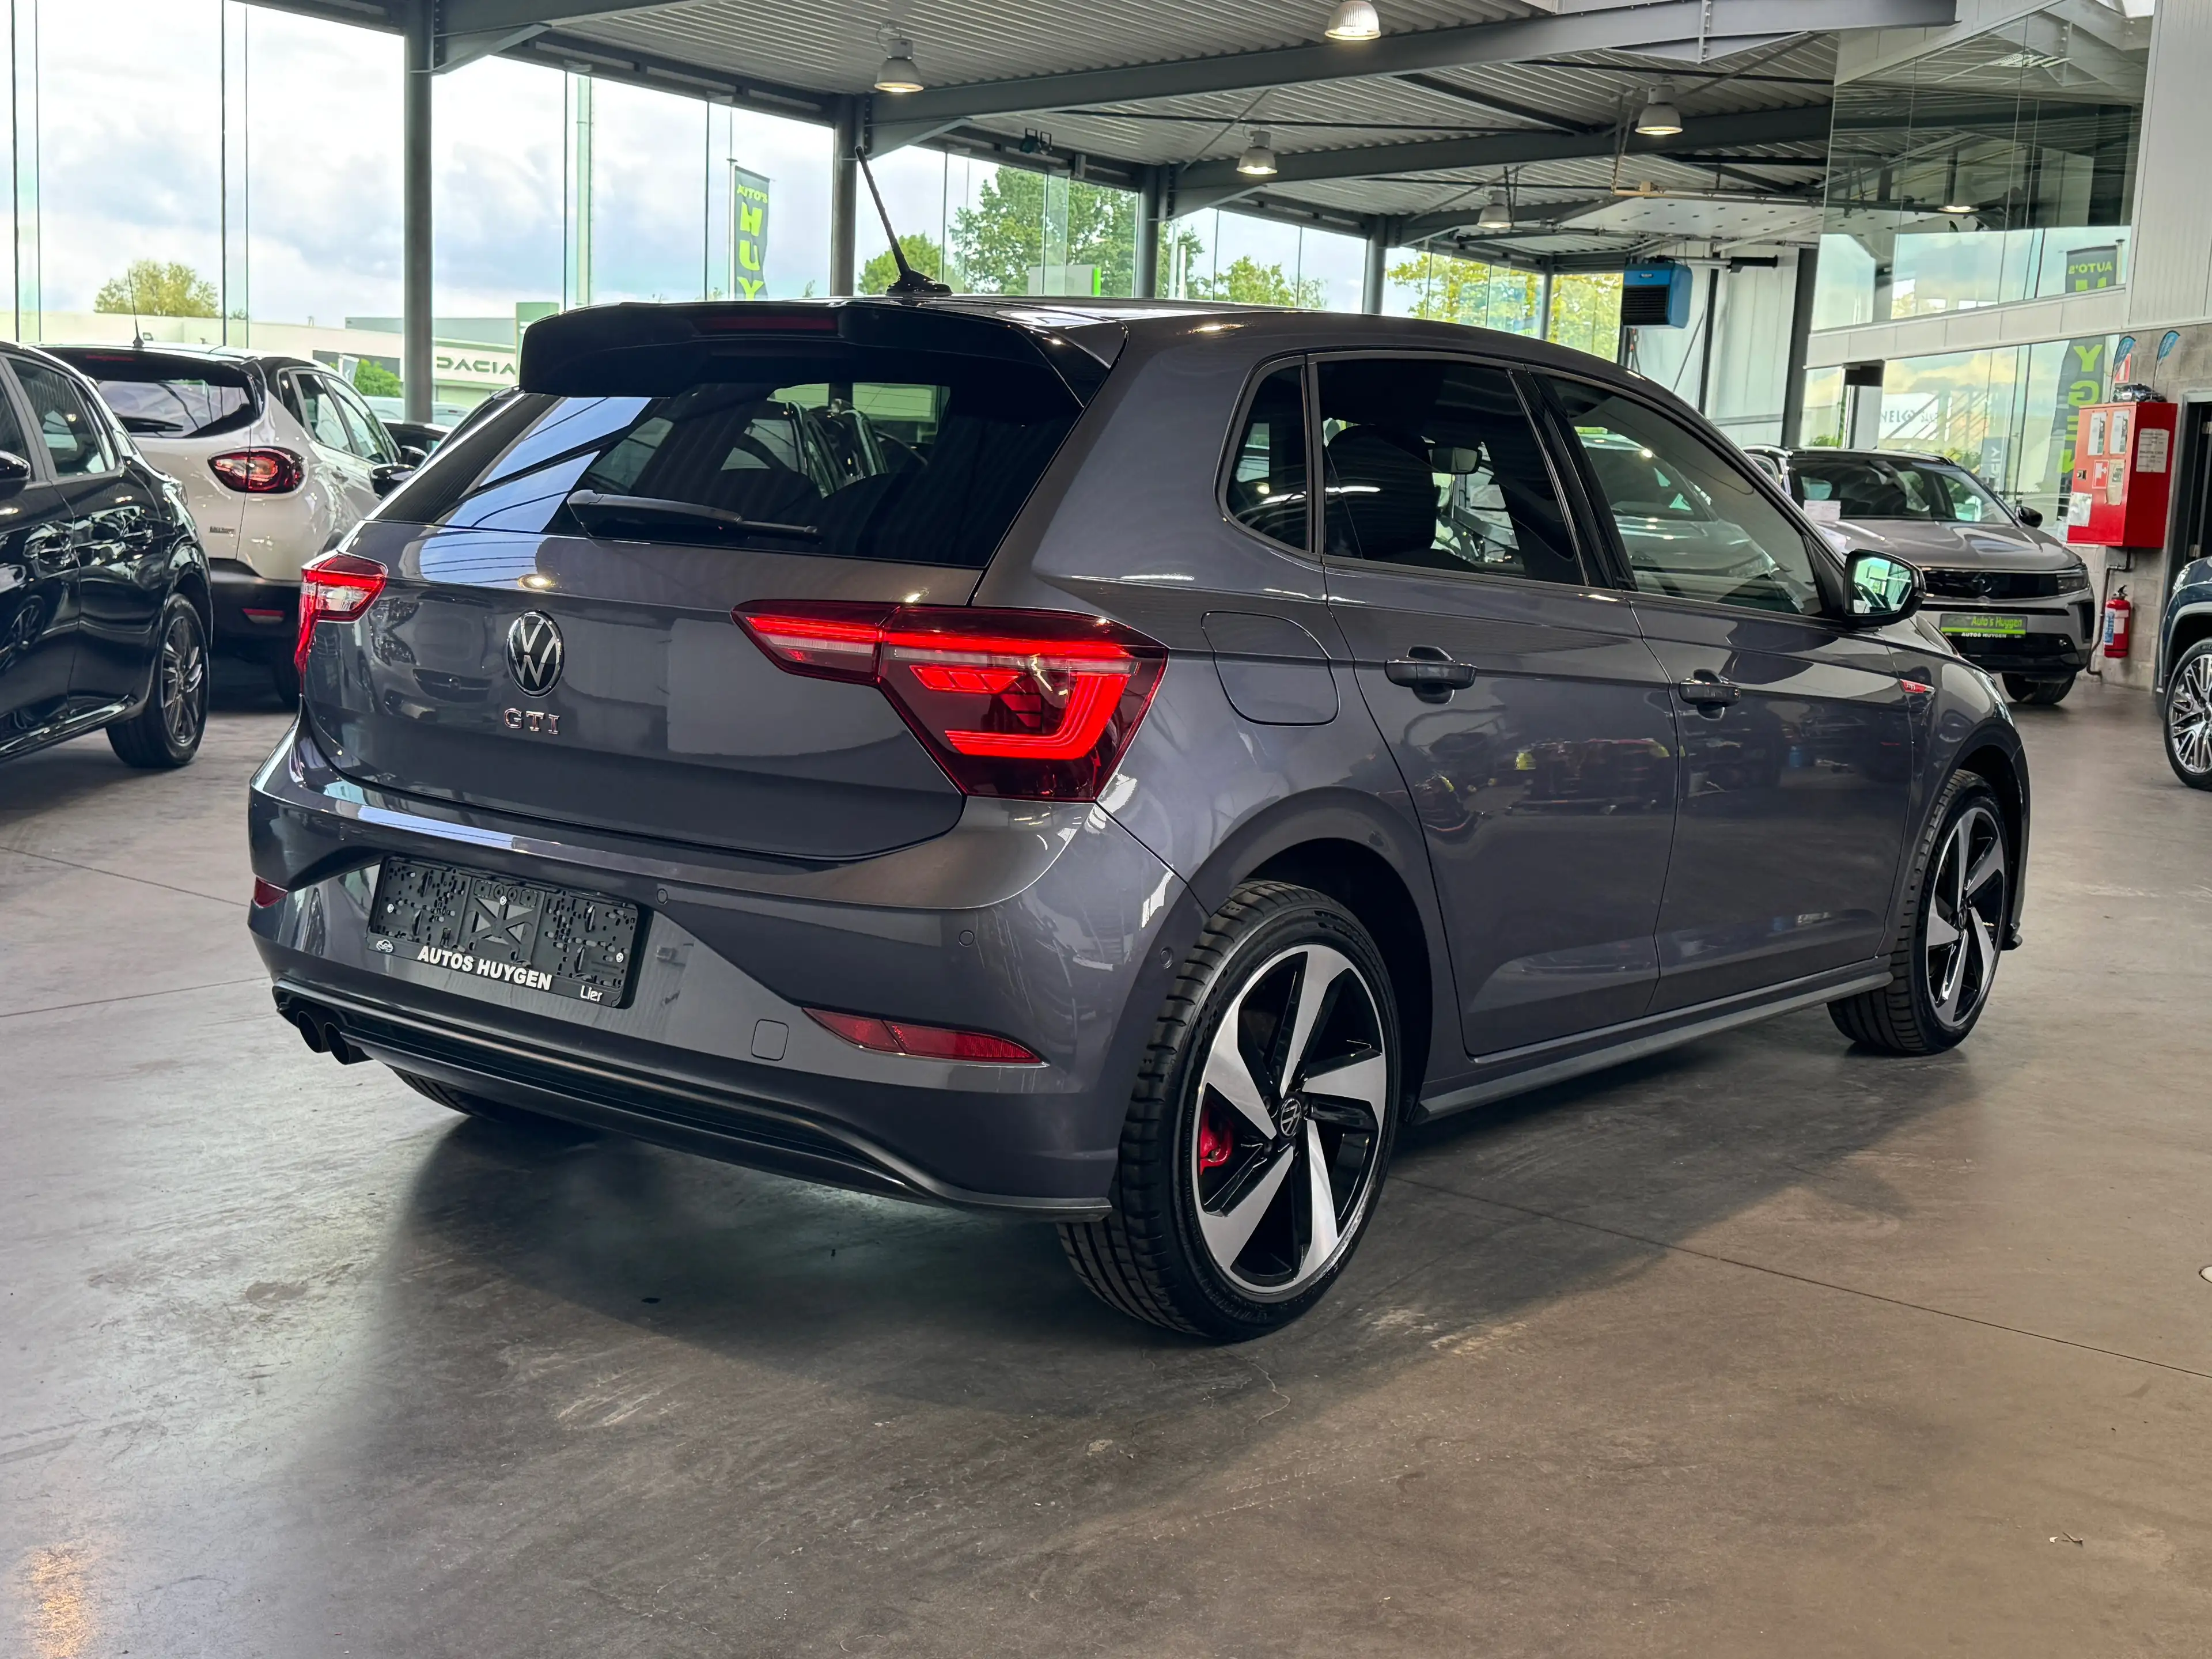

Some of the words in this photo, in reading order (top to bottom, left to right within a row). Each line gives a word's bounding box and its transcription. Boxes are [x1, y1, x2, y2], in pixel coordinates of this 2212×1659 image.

[437, 356, 516, 375] DACIA
[1995, 616, 2022, 629] Huygen
[504, 708, 560, 734] GTI
[418, 946, 474, 972] AUTOS
[477, 959, 552, 991] HUYGEN
[580, 985, 603, 1003] Lier
